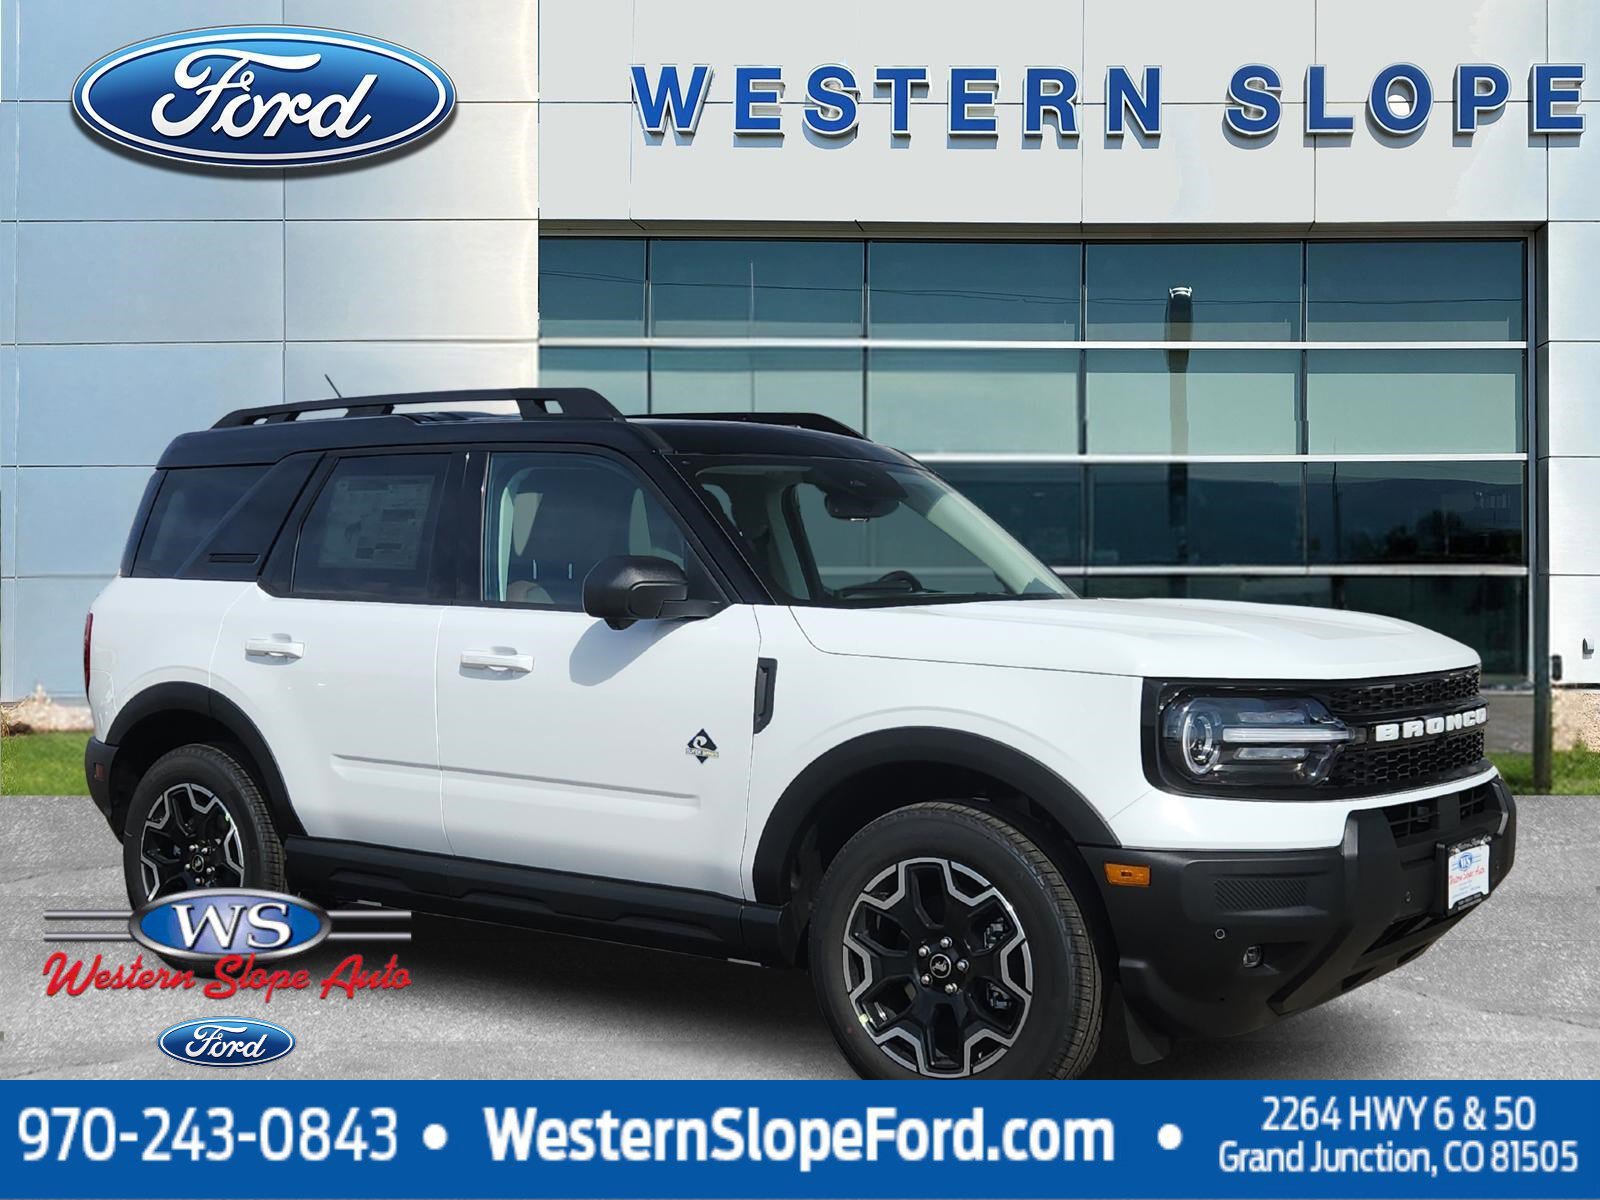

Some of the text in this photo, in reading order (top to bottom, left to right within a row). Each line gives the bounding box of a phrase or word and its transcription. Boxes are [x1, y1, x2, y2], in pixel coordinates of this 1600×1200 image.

[151, 48, 378, 139] Ford
[630, 62, 1586, 138] WESTERN SLOPE
[1375, 707, 1487, 741] BRONCO
